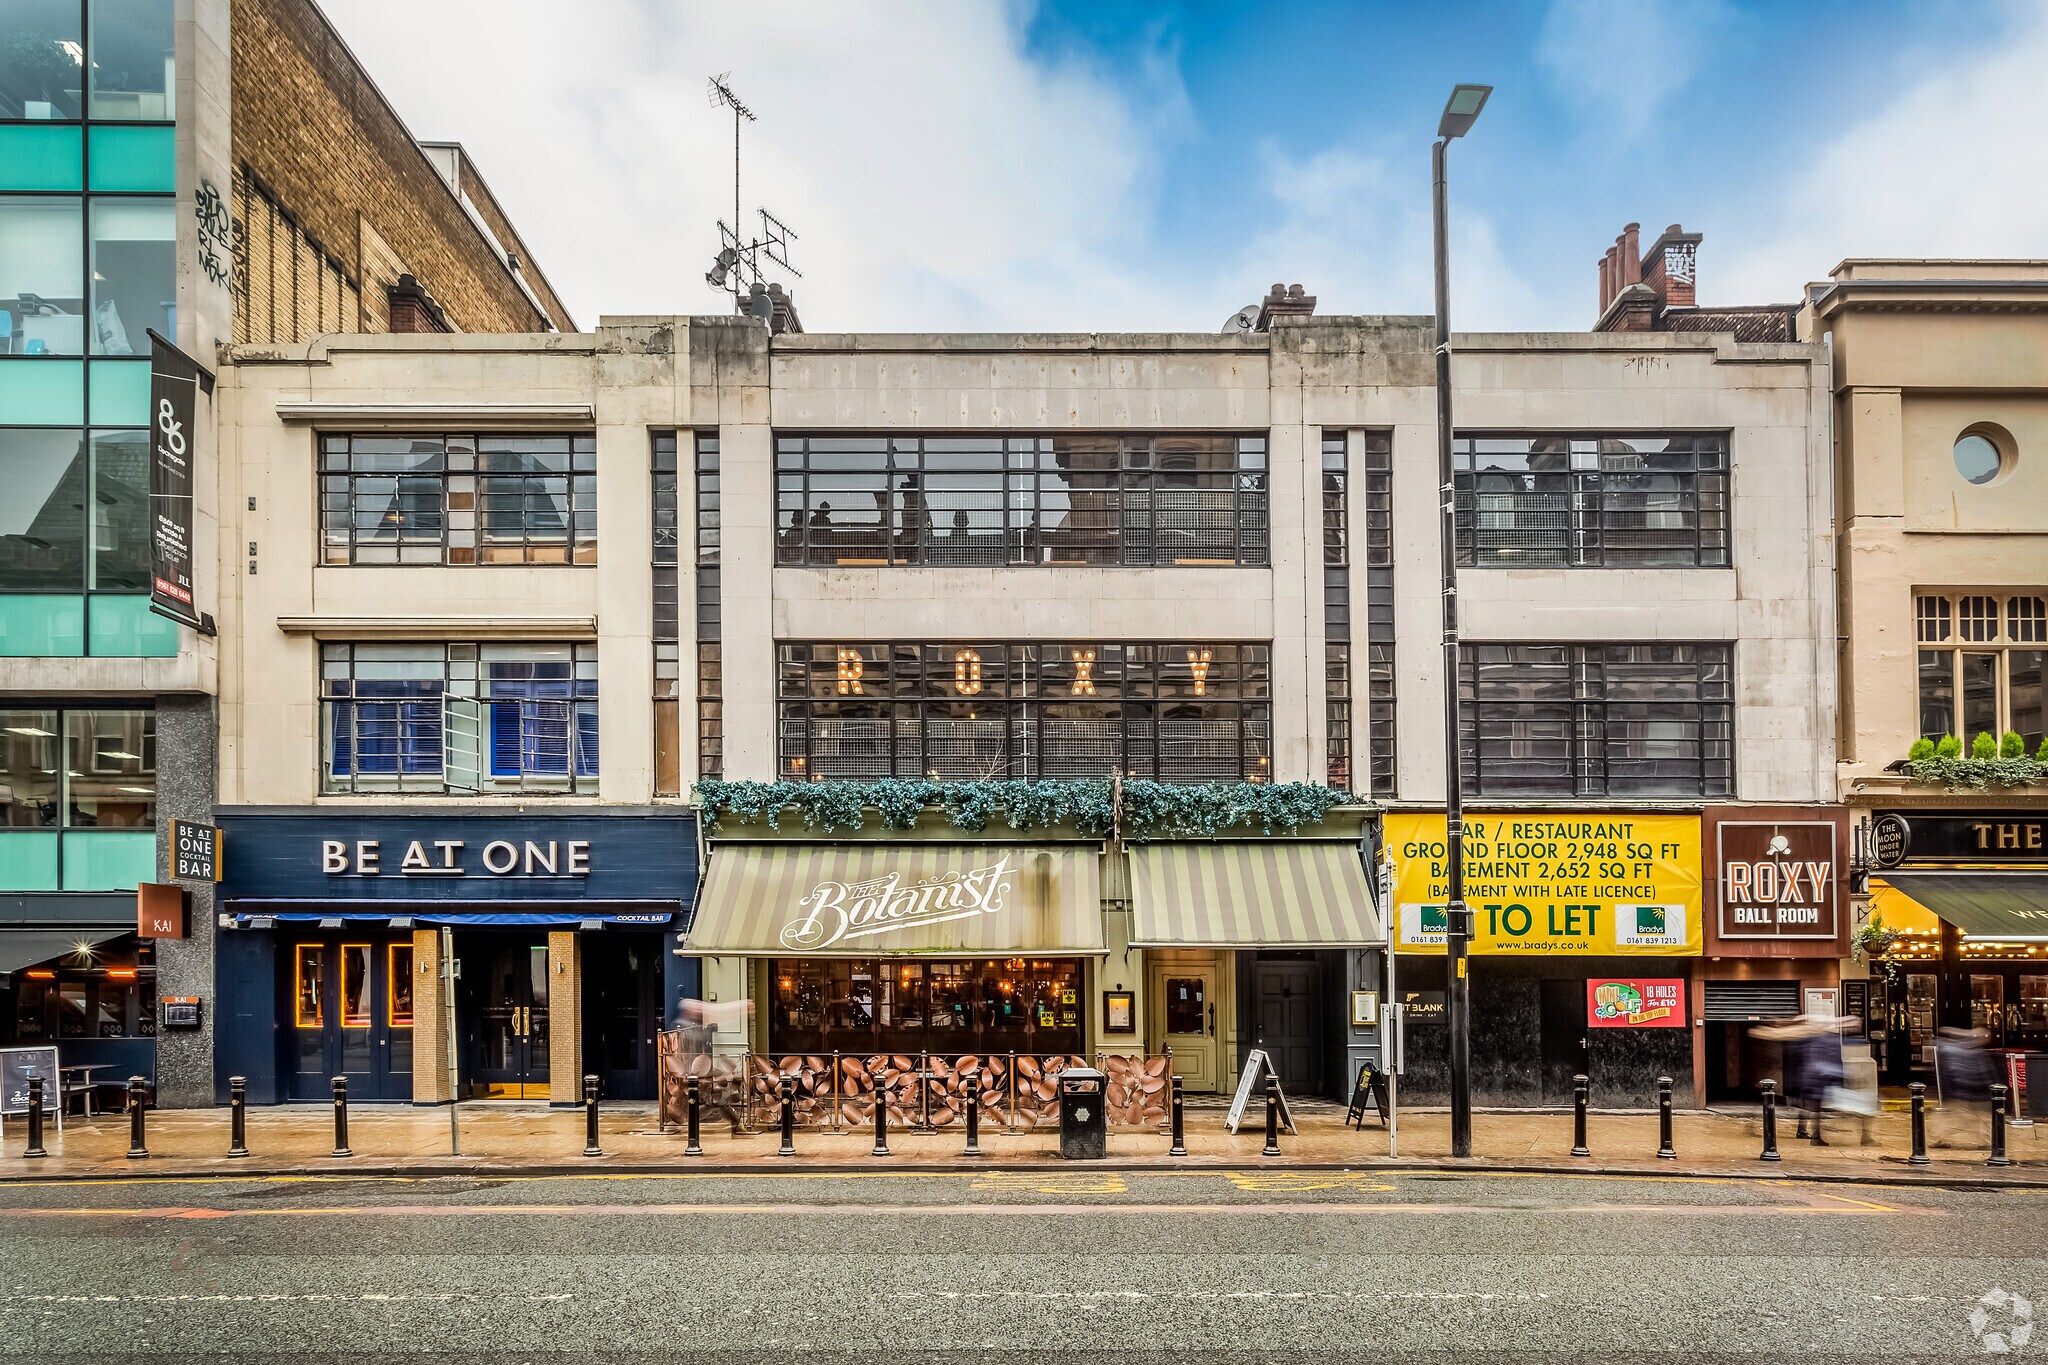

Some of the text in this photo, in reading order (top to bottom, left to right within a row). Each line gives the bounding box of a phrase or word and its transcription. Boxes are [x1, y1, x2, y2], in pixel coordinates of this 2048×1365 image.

[159, 398, 186, 455] 86
[837, 645, 1212, 696] ROXY
[180, 825, 211, 840] BE AT
[1462, 822, 1486, 839] AR
[1512, 823, 1634, 839] RESTAURANT
[1881, 824, 1897, 833] THE
[1972, 823, 2042, 849] THE
[1878, 832, 1902, 843] MOON
[180, 838, 212, 855] ONE
[1403, 842, 1489, 859] GROND
[1497, 842, 1559, 859] FLOOR
[1566, 842, 1618, 861] 2,948
[1626, 843, 1653, 860] SQ
[1661, 844, 1680, 859] FT
[1880, 843, 1900, 851] UNDER
[1880, 850, 1900, 859] WATER
[180, 852, 211, 862] COCKTAIL
[322, 840, 590, 874] BE AT ONE
[180, 860, 211, 877] BAR
[1538, 862, 1591, 881] 2,652
[1598, 863, 1626, 879] SQ
[1633, 863, 1653, 879] FT
[1726, 862, 1830, 903] ROXY
[1427, 884, 1657, 900] (BAEMENT WITH LATE LICENCE)
[780, 853, 1017, 950] Botanist
[1483, 903, 1601, 937] TO LET
[1734, 907, 1818, 924] BALL ROOM
[154, 919, 172, 932] KAI
[1638, 925, 1664, 935] Bradys
[1496, 940, 1589, 952] www.bradys.co.uk
[1661, 937, 1677, 945] 1213
[1645, 985, 1677, 998] 18 HOLES
[1412, 1003, 1444, 1012] BLANK
[1602, 999, 1642, 1017] GOLF
[1647, 999, 1677, 1007] For £10
